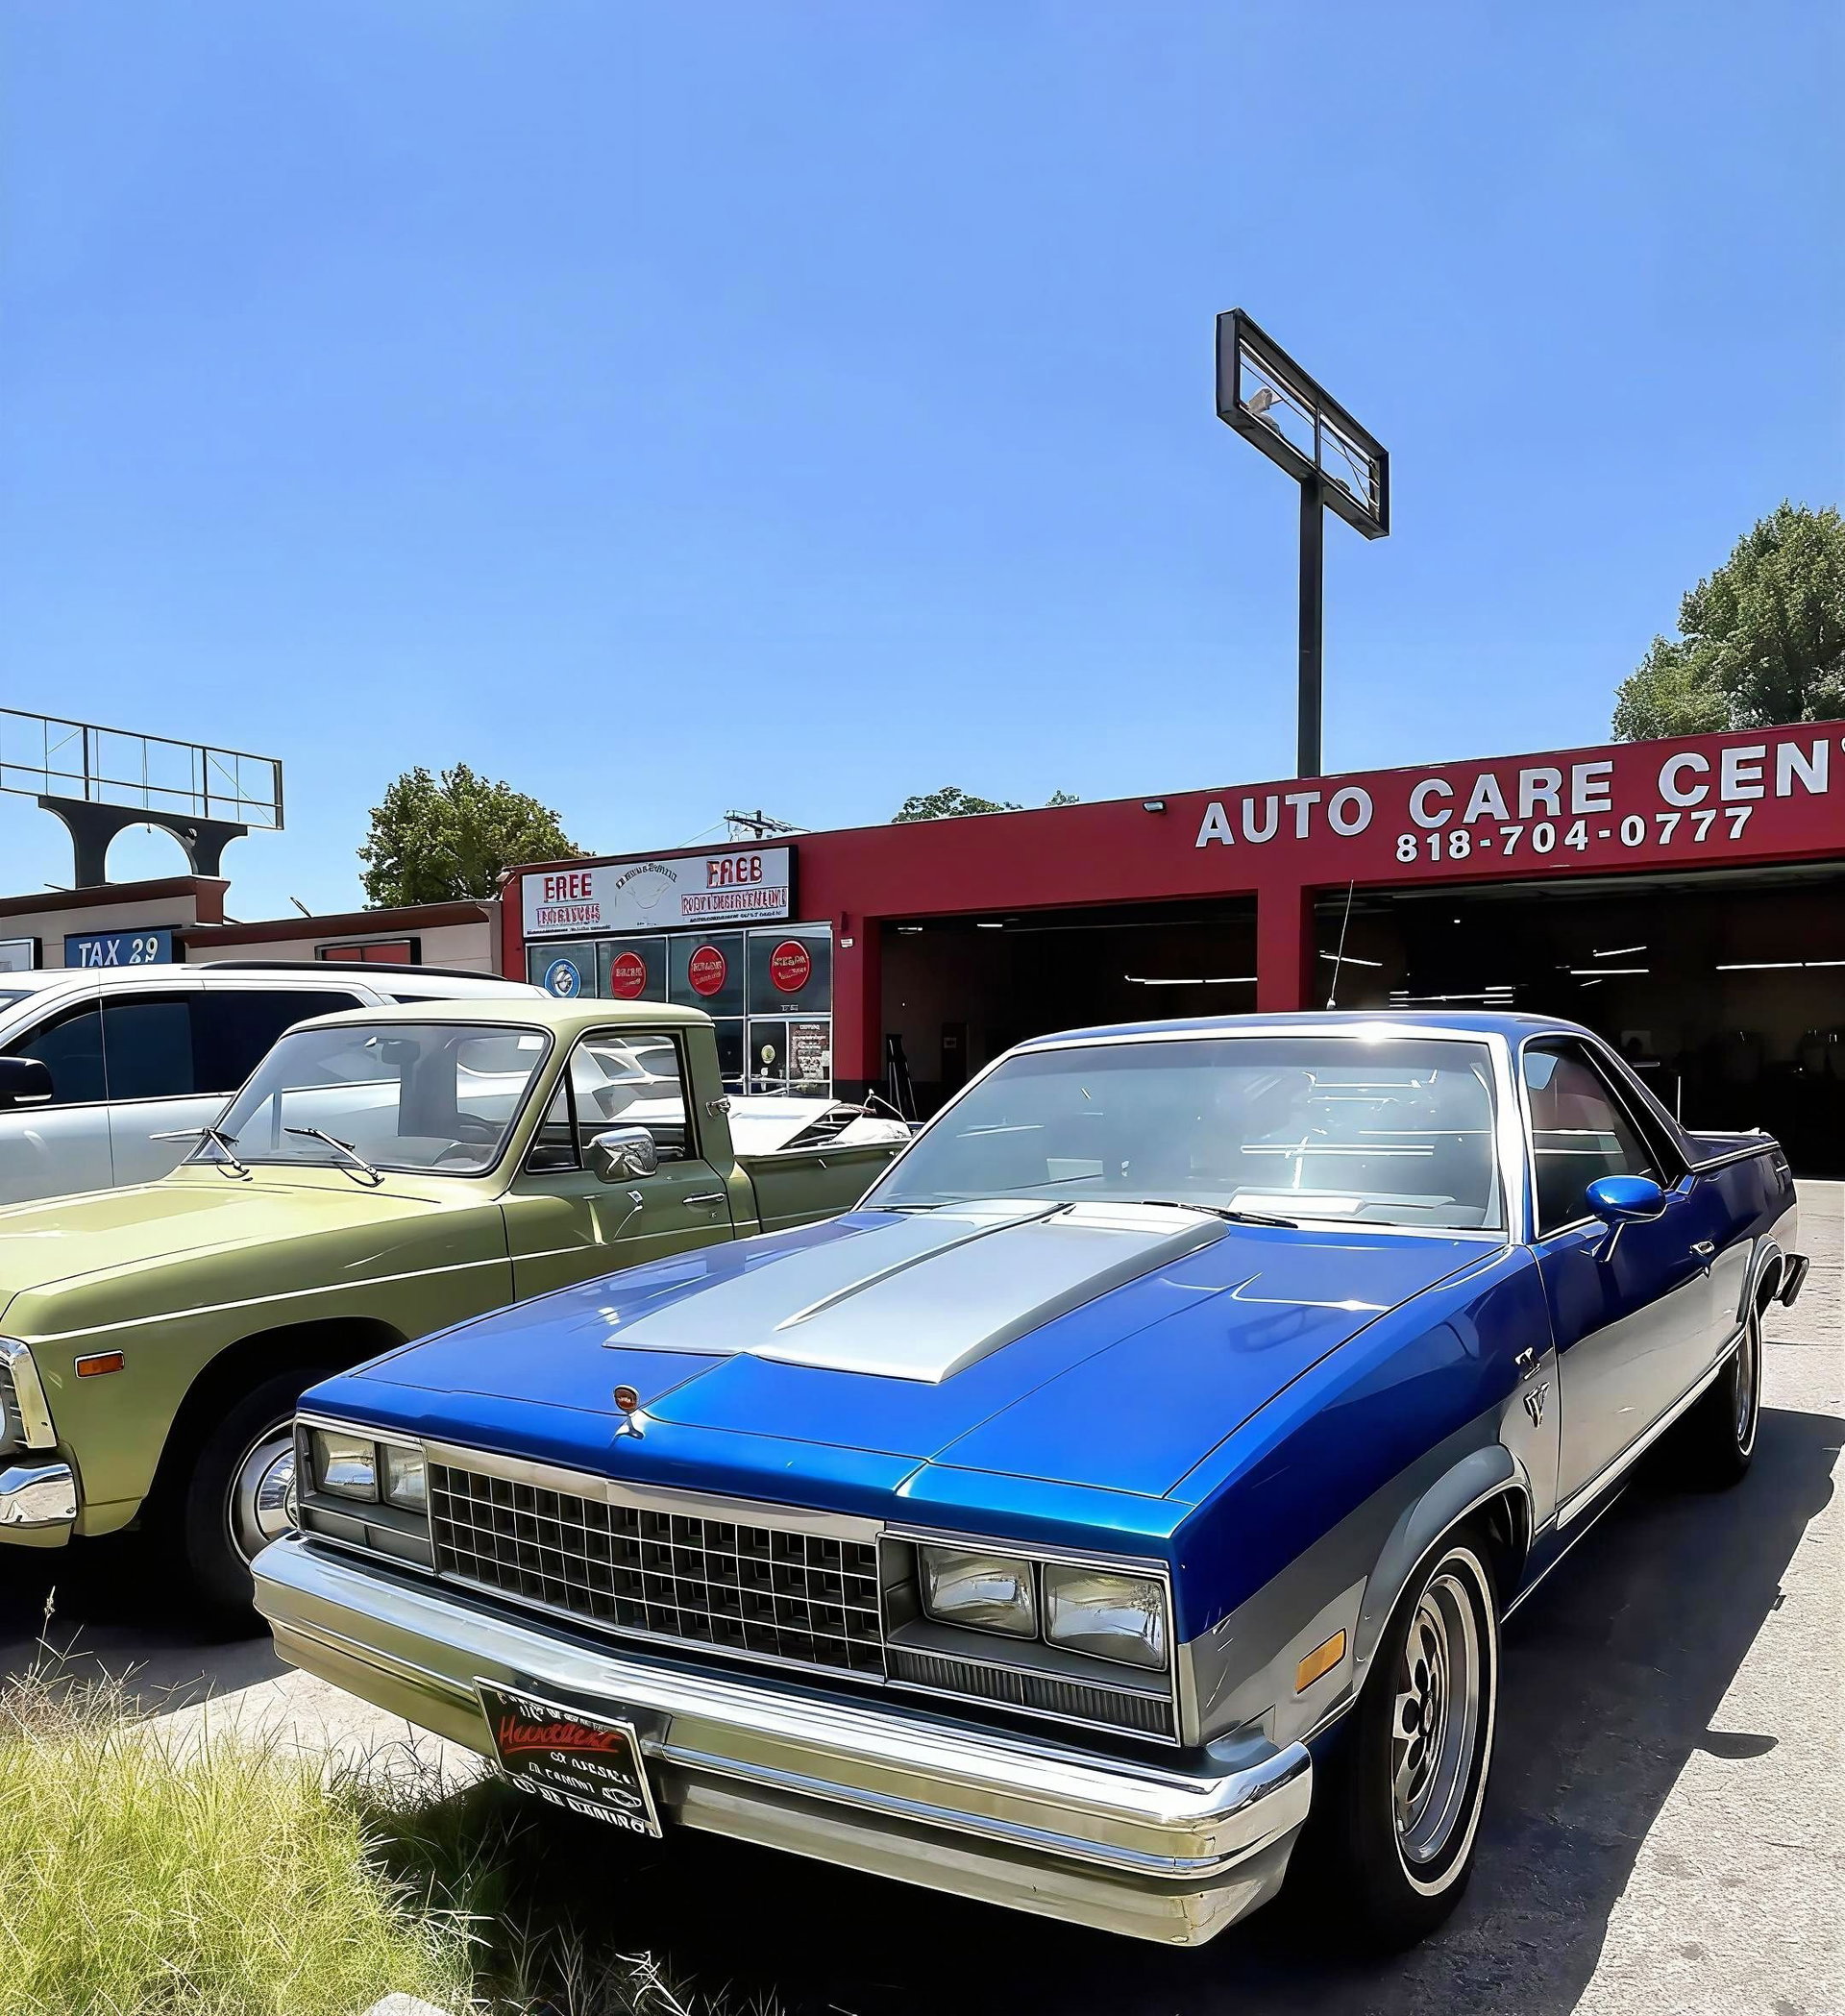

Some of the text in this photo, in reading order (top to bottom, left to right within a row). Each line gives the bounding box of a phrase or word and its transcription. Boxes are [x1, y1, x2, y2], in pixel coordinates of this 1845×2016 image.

[1194, 736, 1845, 848] AUTO CARE CEN
[1395, 805, 1754, 863] 818-704-0777
[78, 939, 120, 968] TAX
